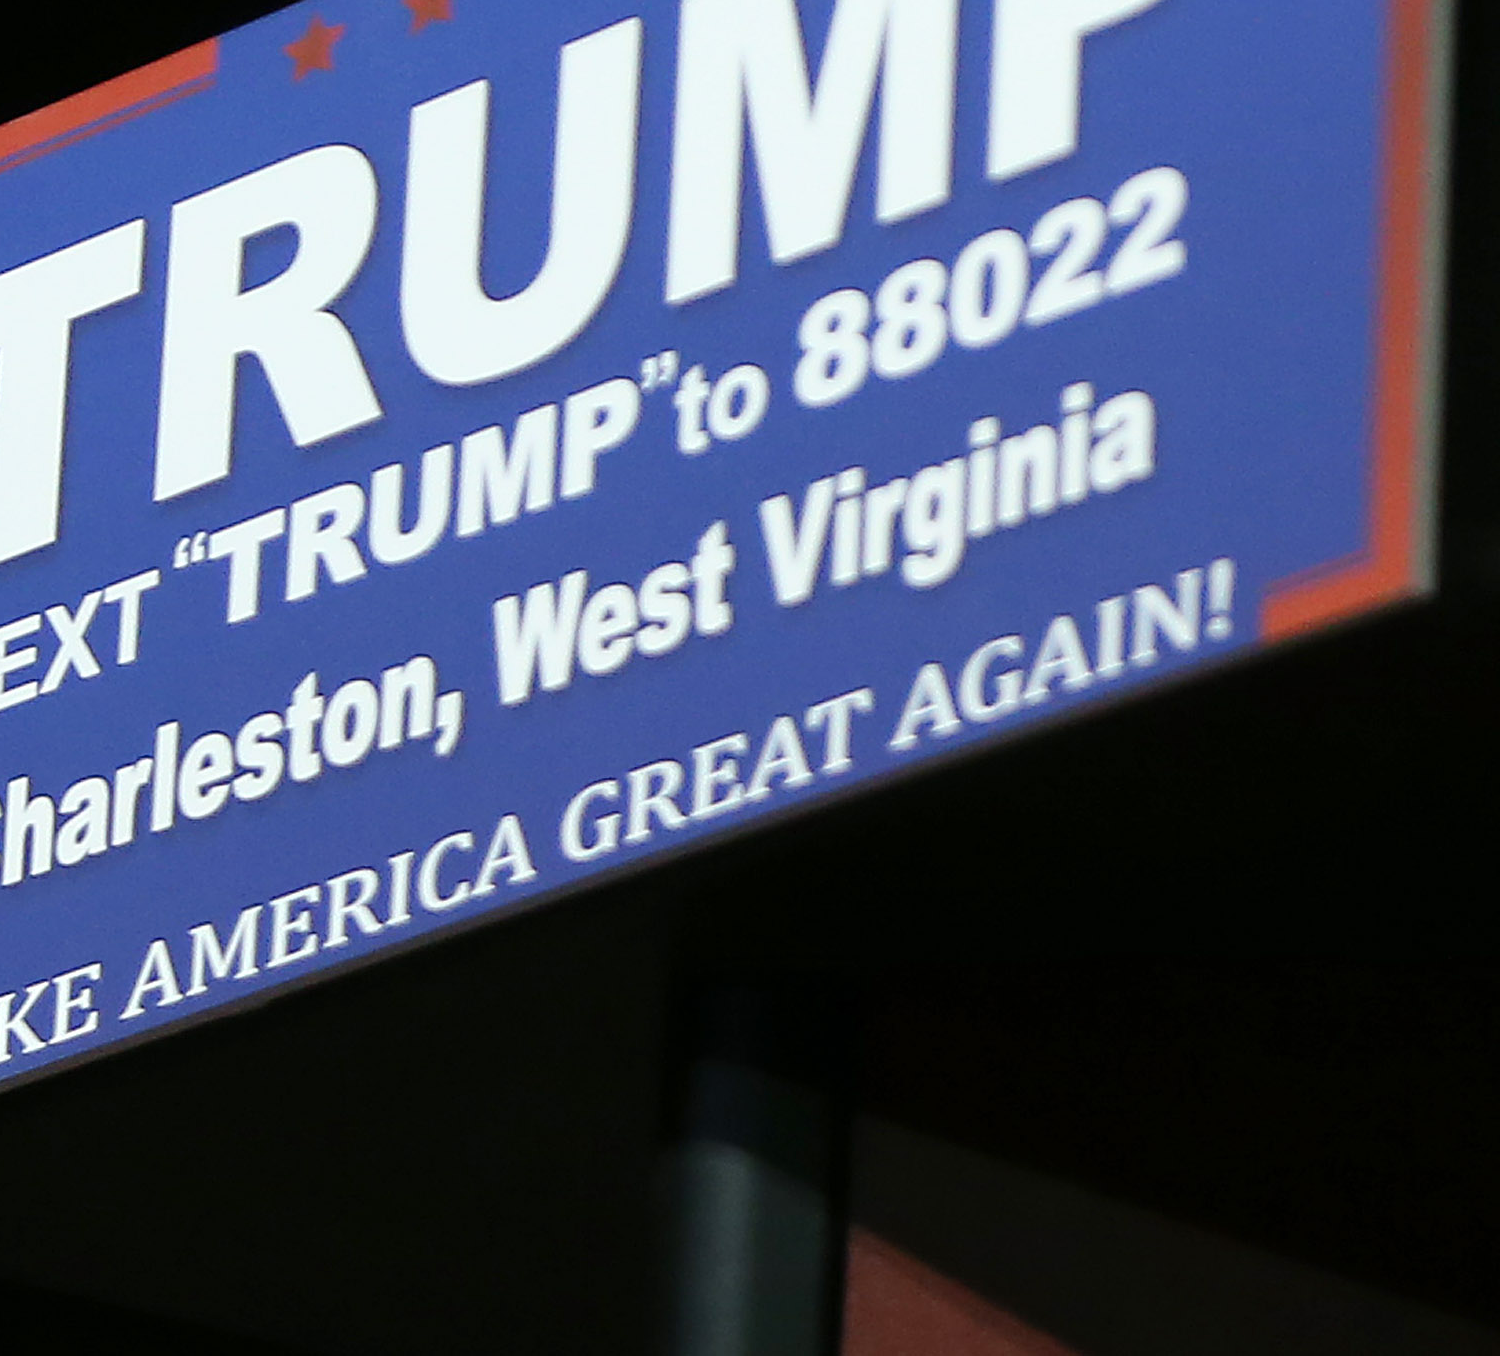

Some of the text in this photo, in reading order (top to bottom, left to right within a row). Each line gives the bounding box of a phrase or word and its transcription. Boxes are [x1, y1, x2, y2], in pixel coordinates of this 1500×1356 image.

[672, 363, 771, 456] to
[792, 165, 1189, 409] 88022
[491, 519, 736, 706] West
[759, 381, 1156, 606] Virginia
[117, 814, 538, 1021] AMERICA
[559, 687, 874, 863] GREAT
[888, 557, 1235, 752] AGAIN!
